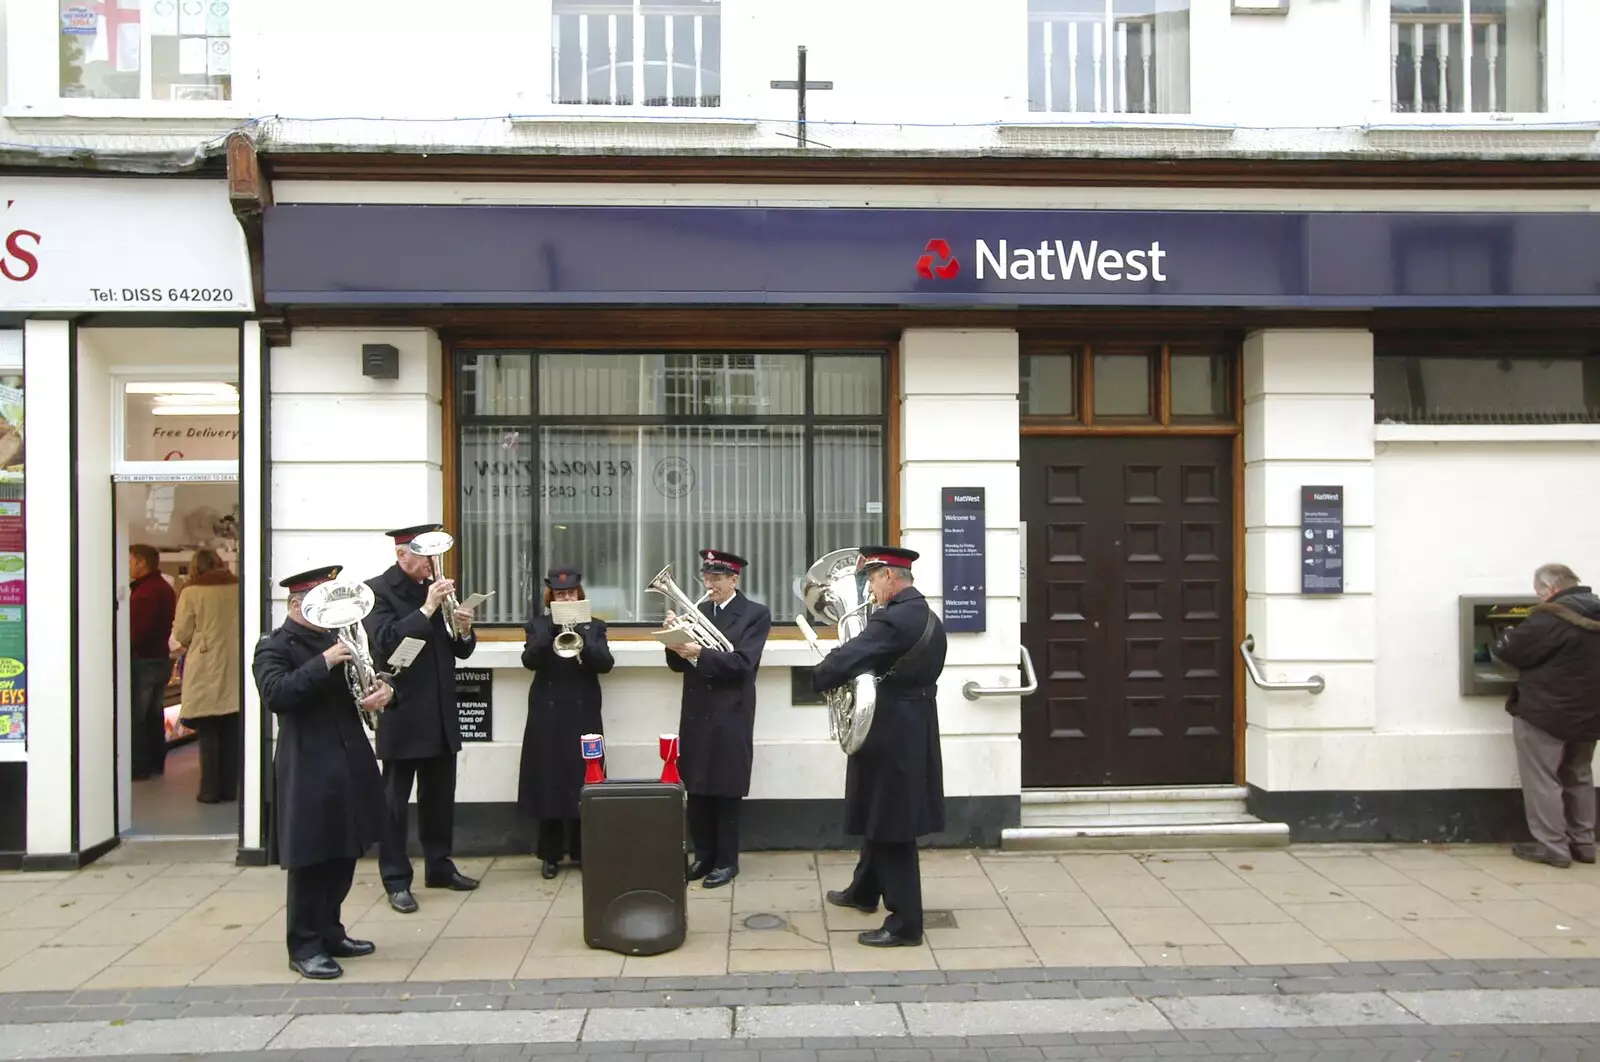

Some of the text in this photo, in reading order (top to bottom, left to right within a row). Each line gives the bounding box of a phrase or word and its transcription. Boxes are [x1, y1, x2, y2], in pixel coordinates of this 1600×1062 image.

[975, 239, 1167, 281] NatWest
[90, 289, 233, 301] Tel: DISS 642020
[153, 427, 239, 440] Free Delivery
[954, 495, 981, 503] NatWest
[1313, 493, 1339, 501] NatWest
[454, 672, 490, 681] atWest
[0, 688, 25, 704] EYS
